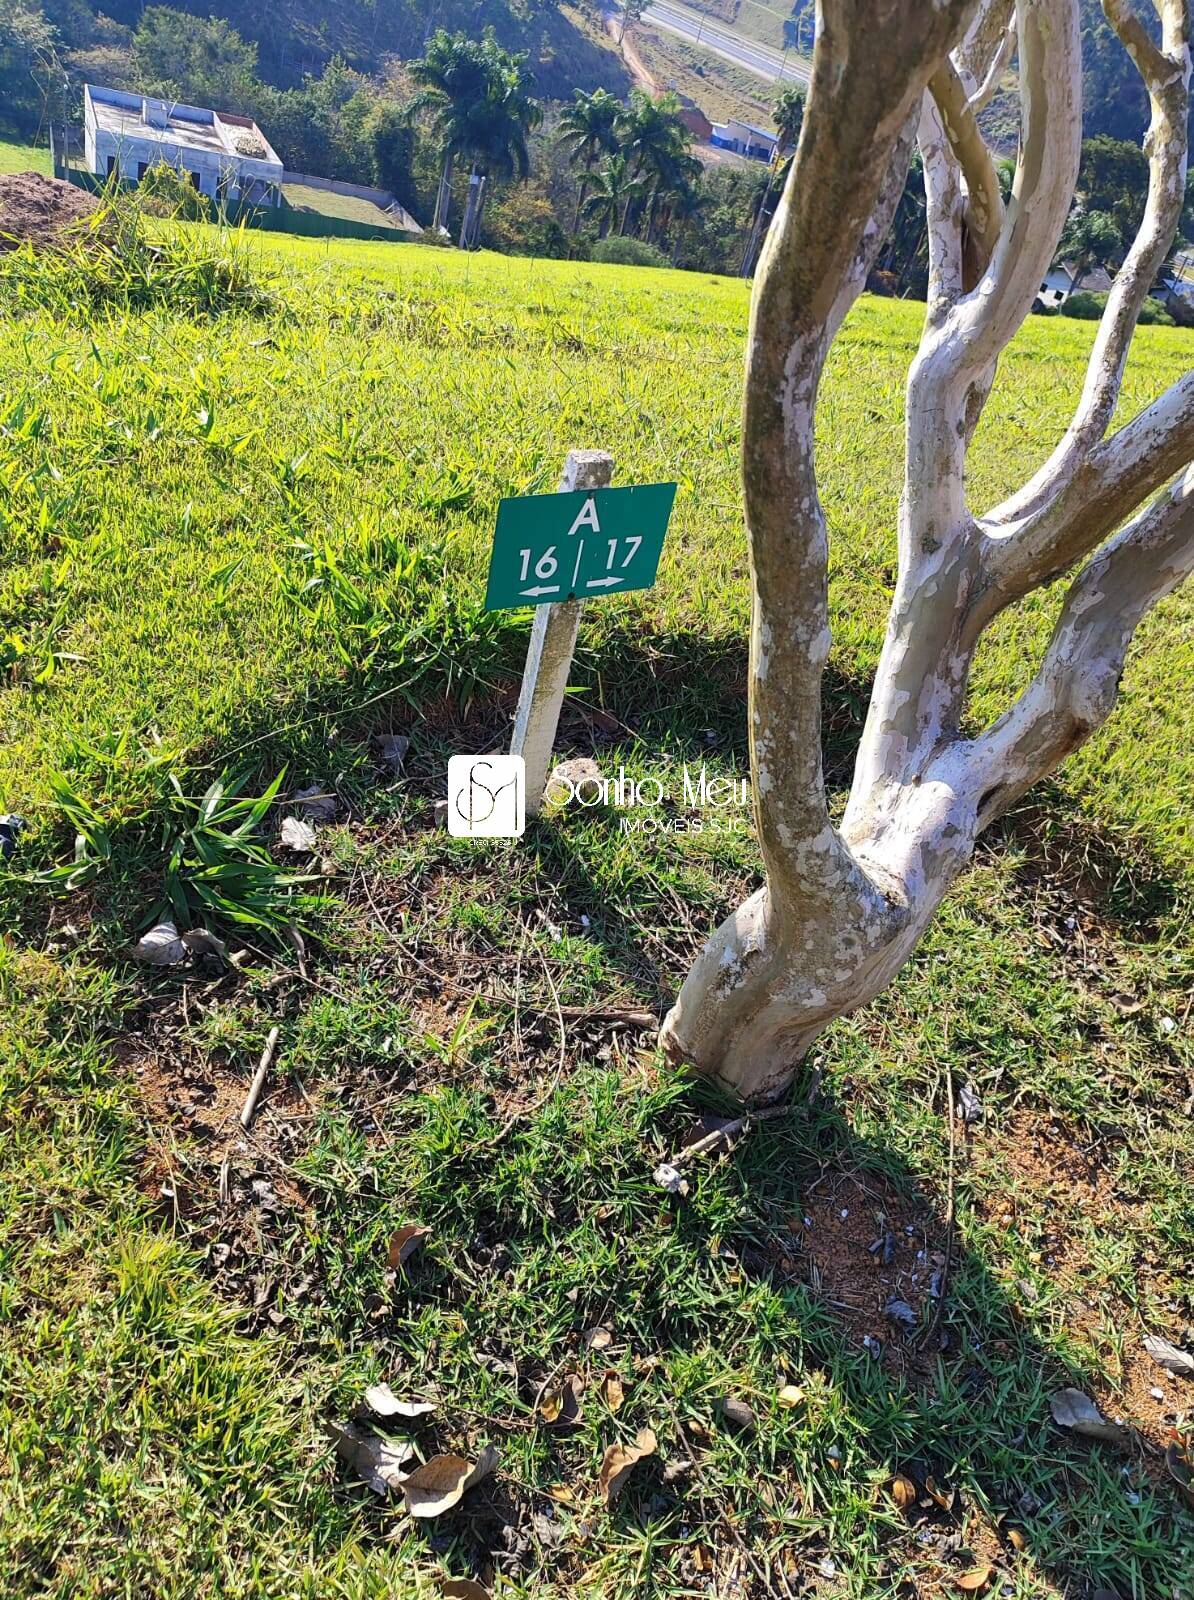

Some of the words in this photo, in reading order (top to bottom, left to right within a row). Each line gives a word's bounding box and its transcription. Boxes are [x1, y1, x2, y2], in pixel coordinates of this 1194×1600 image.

[568, 498, 600, 535] A
[519, 546, 558, 581] 16
[606, 535, 642, 569] 17
